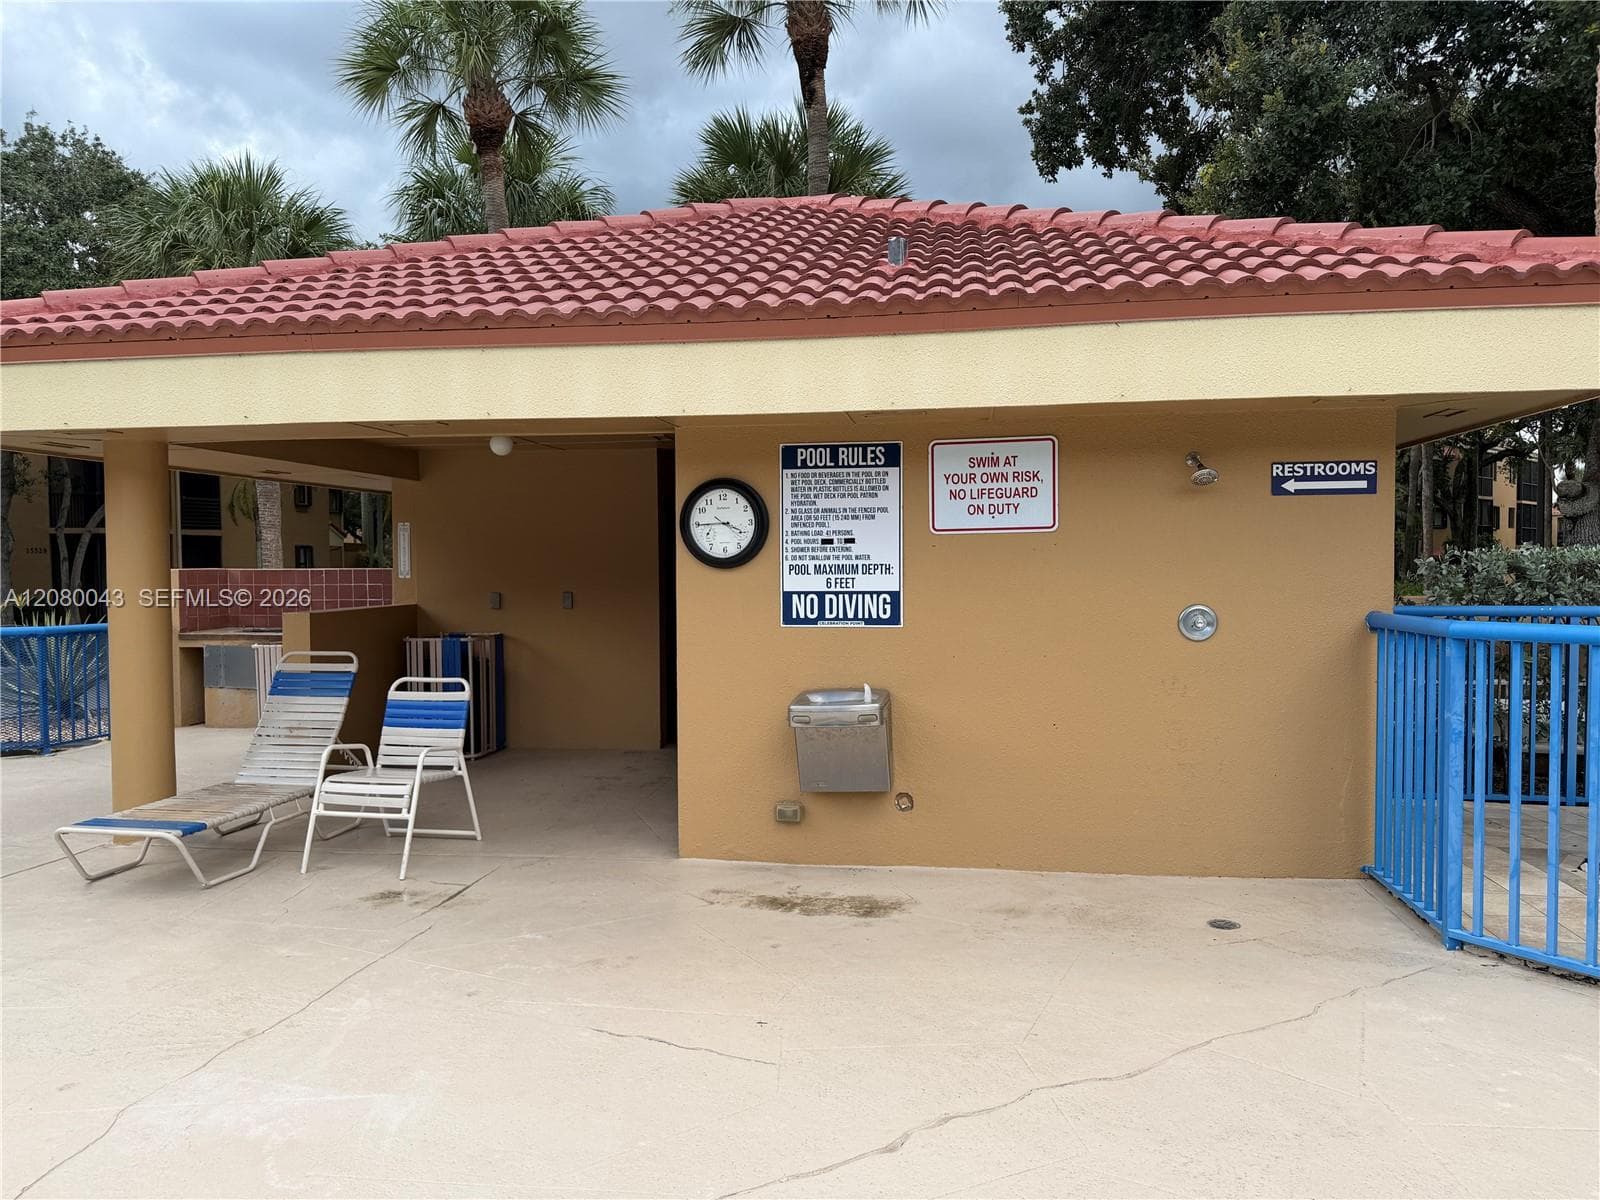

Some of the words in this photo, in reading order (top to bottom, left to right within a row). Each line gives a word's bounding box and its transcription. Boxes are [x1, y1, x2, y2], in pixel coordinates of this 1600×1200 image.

[797, 448, 834, 466] POOL
[839, 447, 885, 466] RULES
[968, 456, 999, 468] SWIM
[1003, 456, 1018, 467] AT
[1273, 462, 1375, 476] RESTROOMS
[944, 473, 976, 484] YOUR
[981, 472, 1008, 484] OWN
[1012, 471, 1044, 484] RISK,
[949, 489, 966, 500] NO
[970, 487, 1038, 499] LIFEGUARD
[968, 504, 984, 515] ON
[988, 503, 1020, 515] DUTY
[789, 564, 811, 575] POOL
[814, 564, 858, 575] MAXIMUM
[862, 564, 894, 575] DEPTH:
[826, 577, 832, 589] 6
[835, 577, 856, 588] FEET
[792, 594, 818, 619] NO
[825, 594, 891, 619] DIVING
